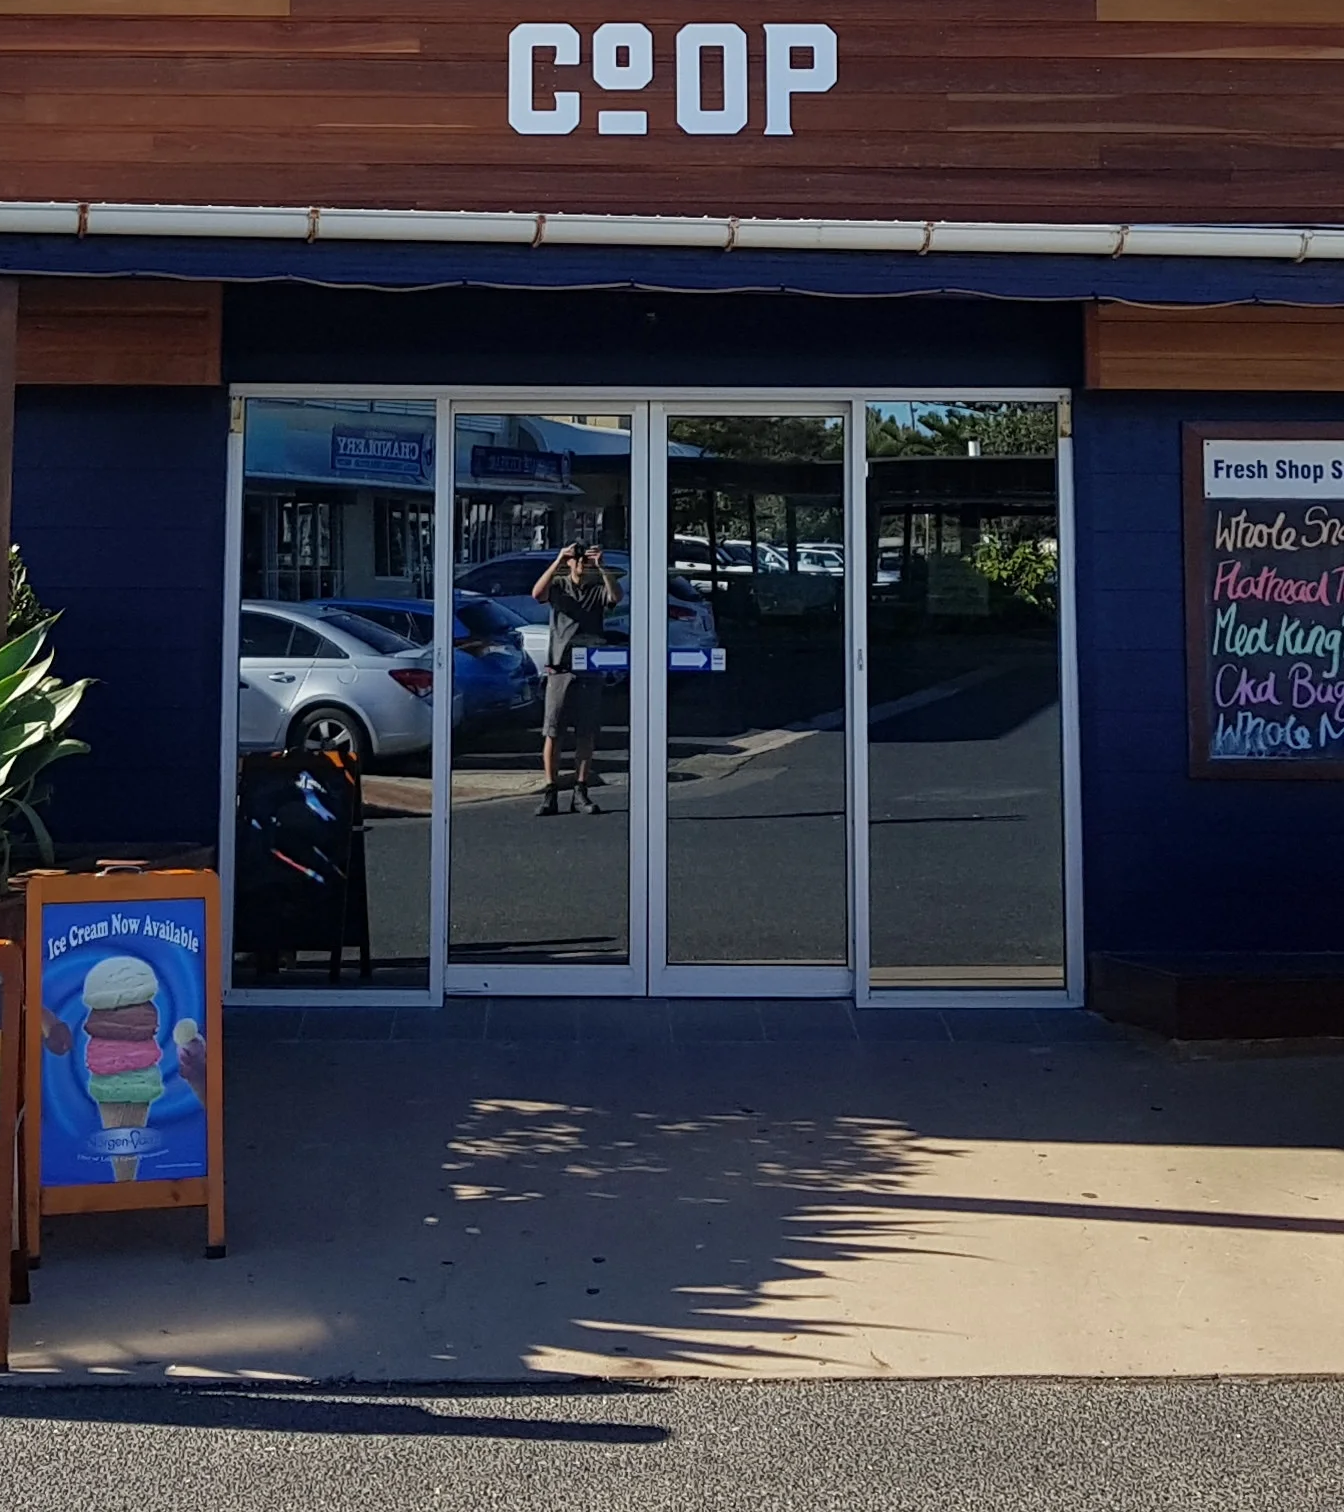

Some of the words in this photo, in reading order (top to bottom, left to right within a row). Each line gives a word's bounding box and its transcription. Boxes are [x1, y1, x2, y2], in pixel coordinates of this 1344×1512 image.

[1213, 459, 1268, 479] Fresh
[1275, 459, 1324, 484] Shop
[1215, 508, 1299, 552] Whole
[1213, 559, 1331, 606] Flathead
[1212, 602, 1274, 657] Med
[1275, 614, 1343, 679] King
[48, 936, 67, 960] Ice
[68, 920, 109, 947] Cream
[111, 912, 141, 936] Now
[142, 914, 199, 953] Available
